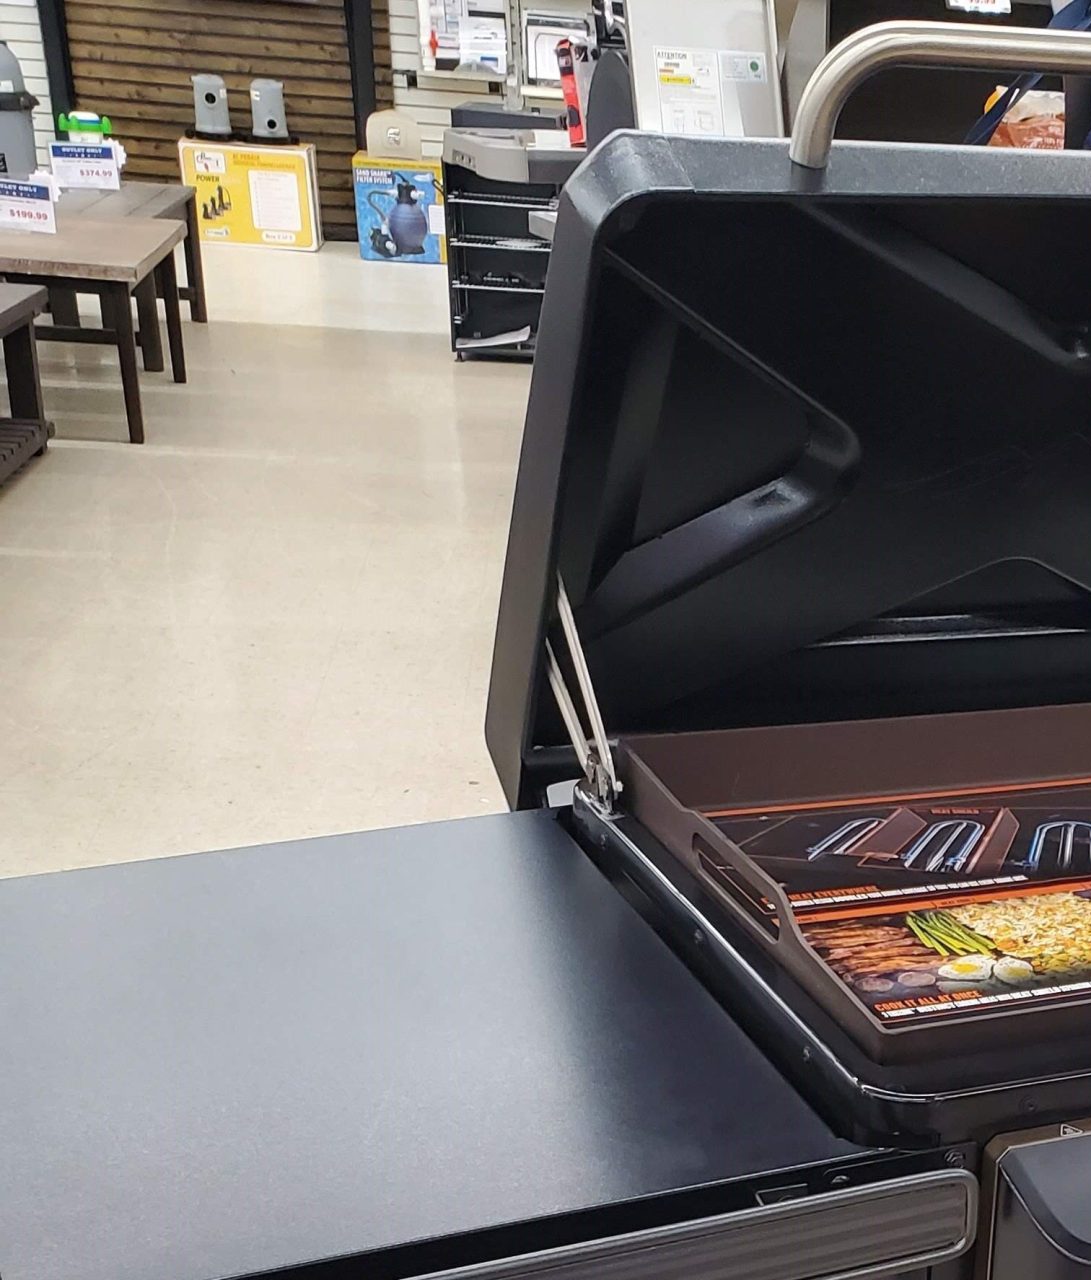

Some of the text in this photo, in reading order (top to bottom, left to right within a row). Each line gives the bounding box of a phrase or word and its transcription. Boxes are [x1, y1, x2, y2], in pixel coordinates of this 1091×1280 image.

[79, 168, 113, 178] $374.99
[195, 174, 220, 183] POWER
[18, 184, 38, 194] ONLY
[9, 209, 48, 221] $199.99
[874, 1001, 906, 1012] COOK
[905, 999, 918, 1008] IT
[918, 997, 939, 1006] ALL
[938, 994, 953, 1002] AT
[952, 990, 982, 1001] ONCE
